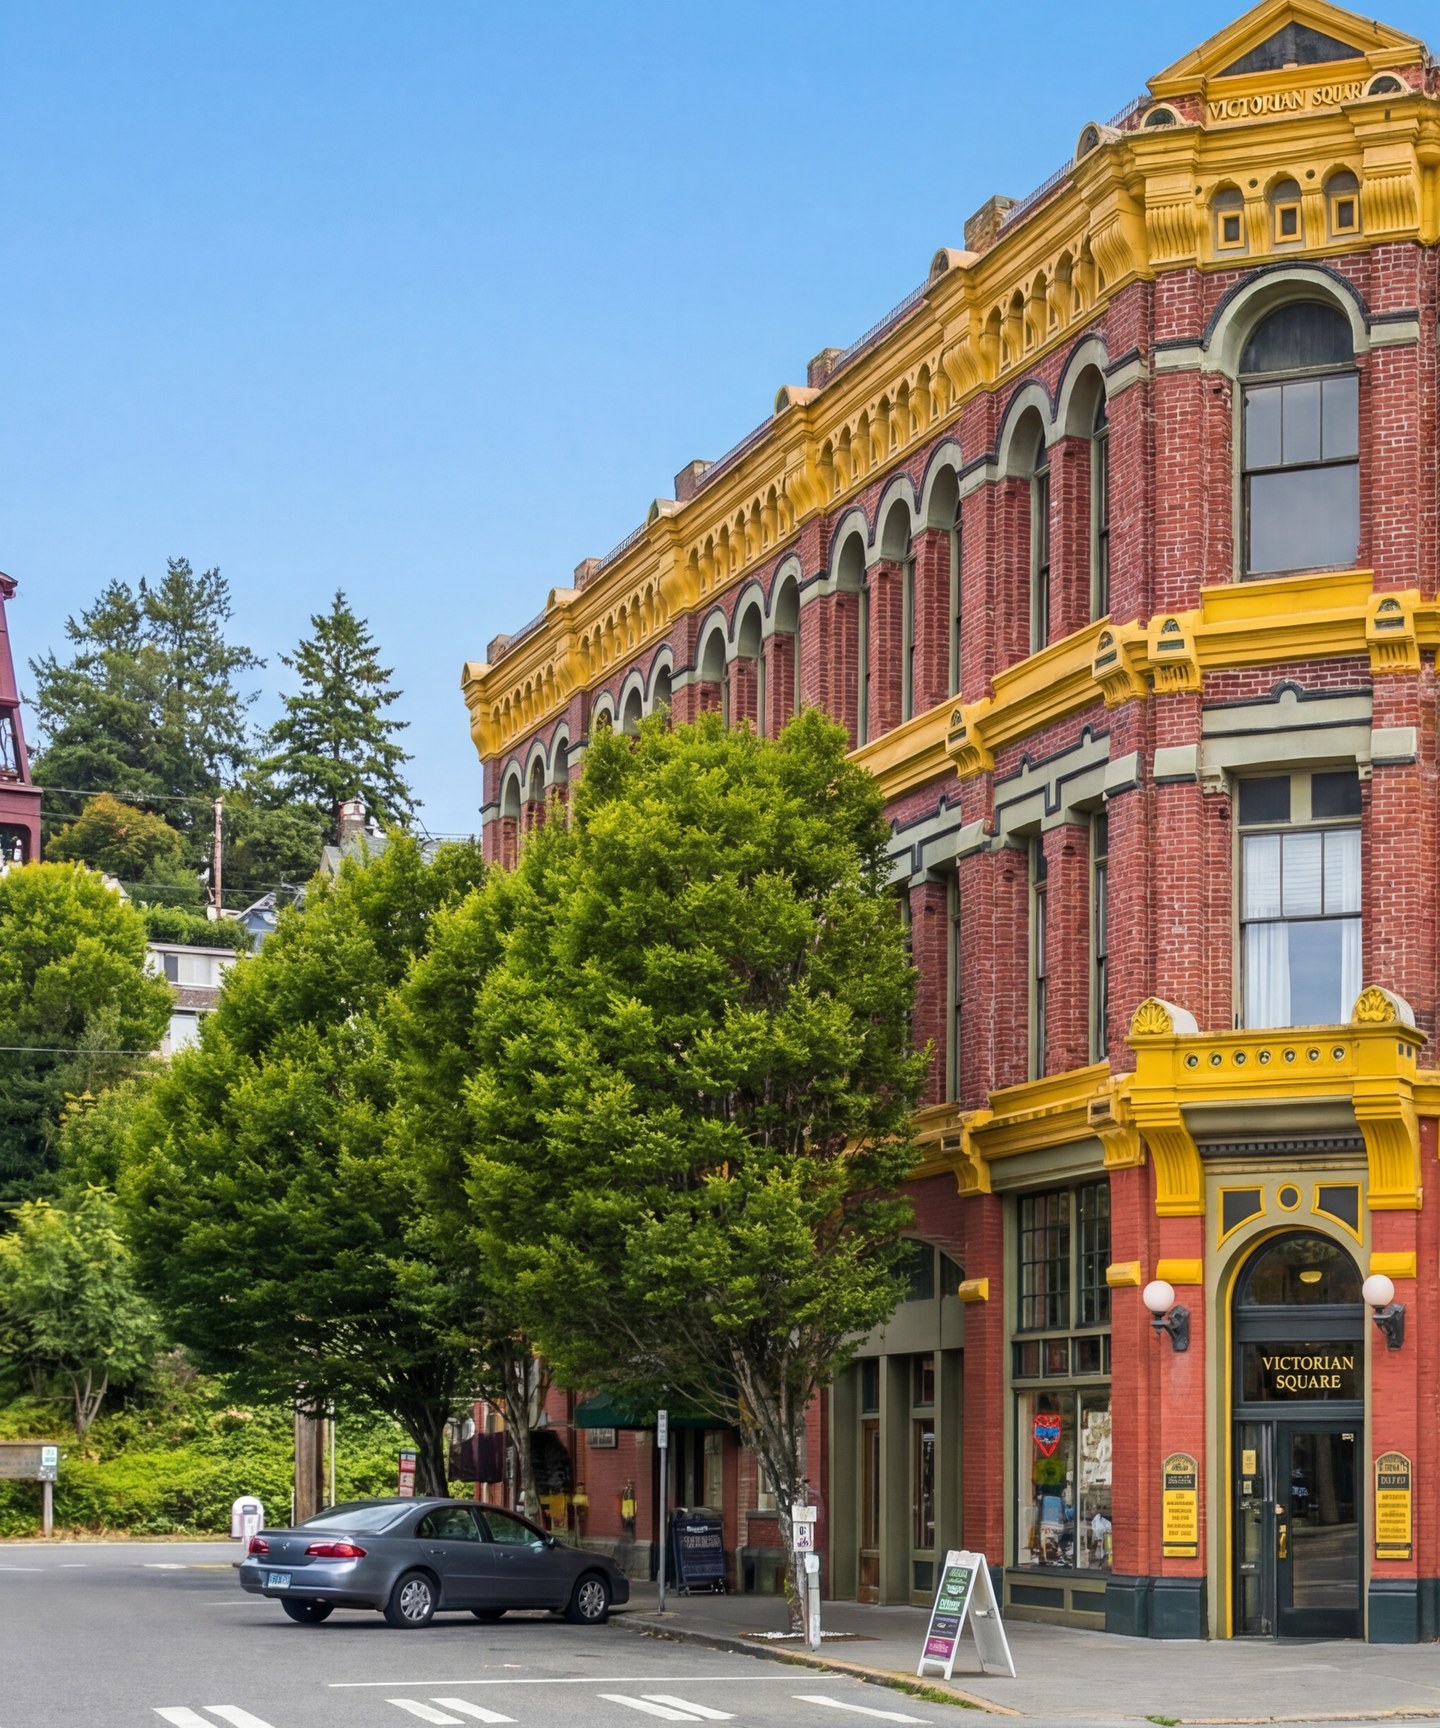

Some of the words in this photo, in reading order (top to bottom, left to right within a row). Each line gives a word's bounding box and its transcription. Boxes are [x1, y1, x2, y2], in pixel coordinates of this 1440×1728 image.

[1208, 90, 1304, 119] VICTORIAN
[1262, 1356, 1354, 1371] VICTORIAN
[1276, 1374, 1342, 1392] SQUARE
